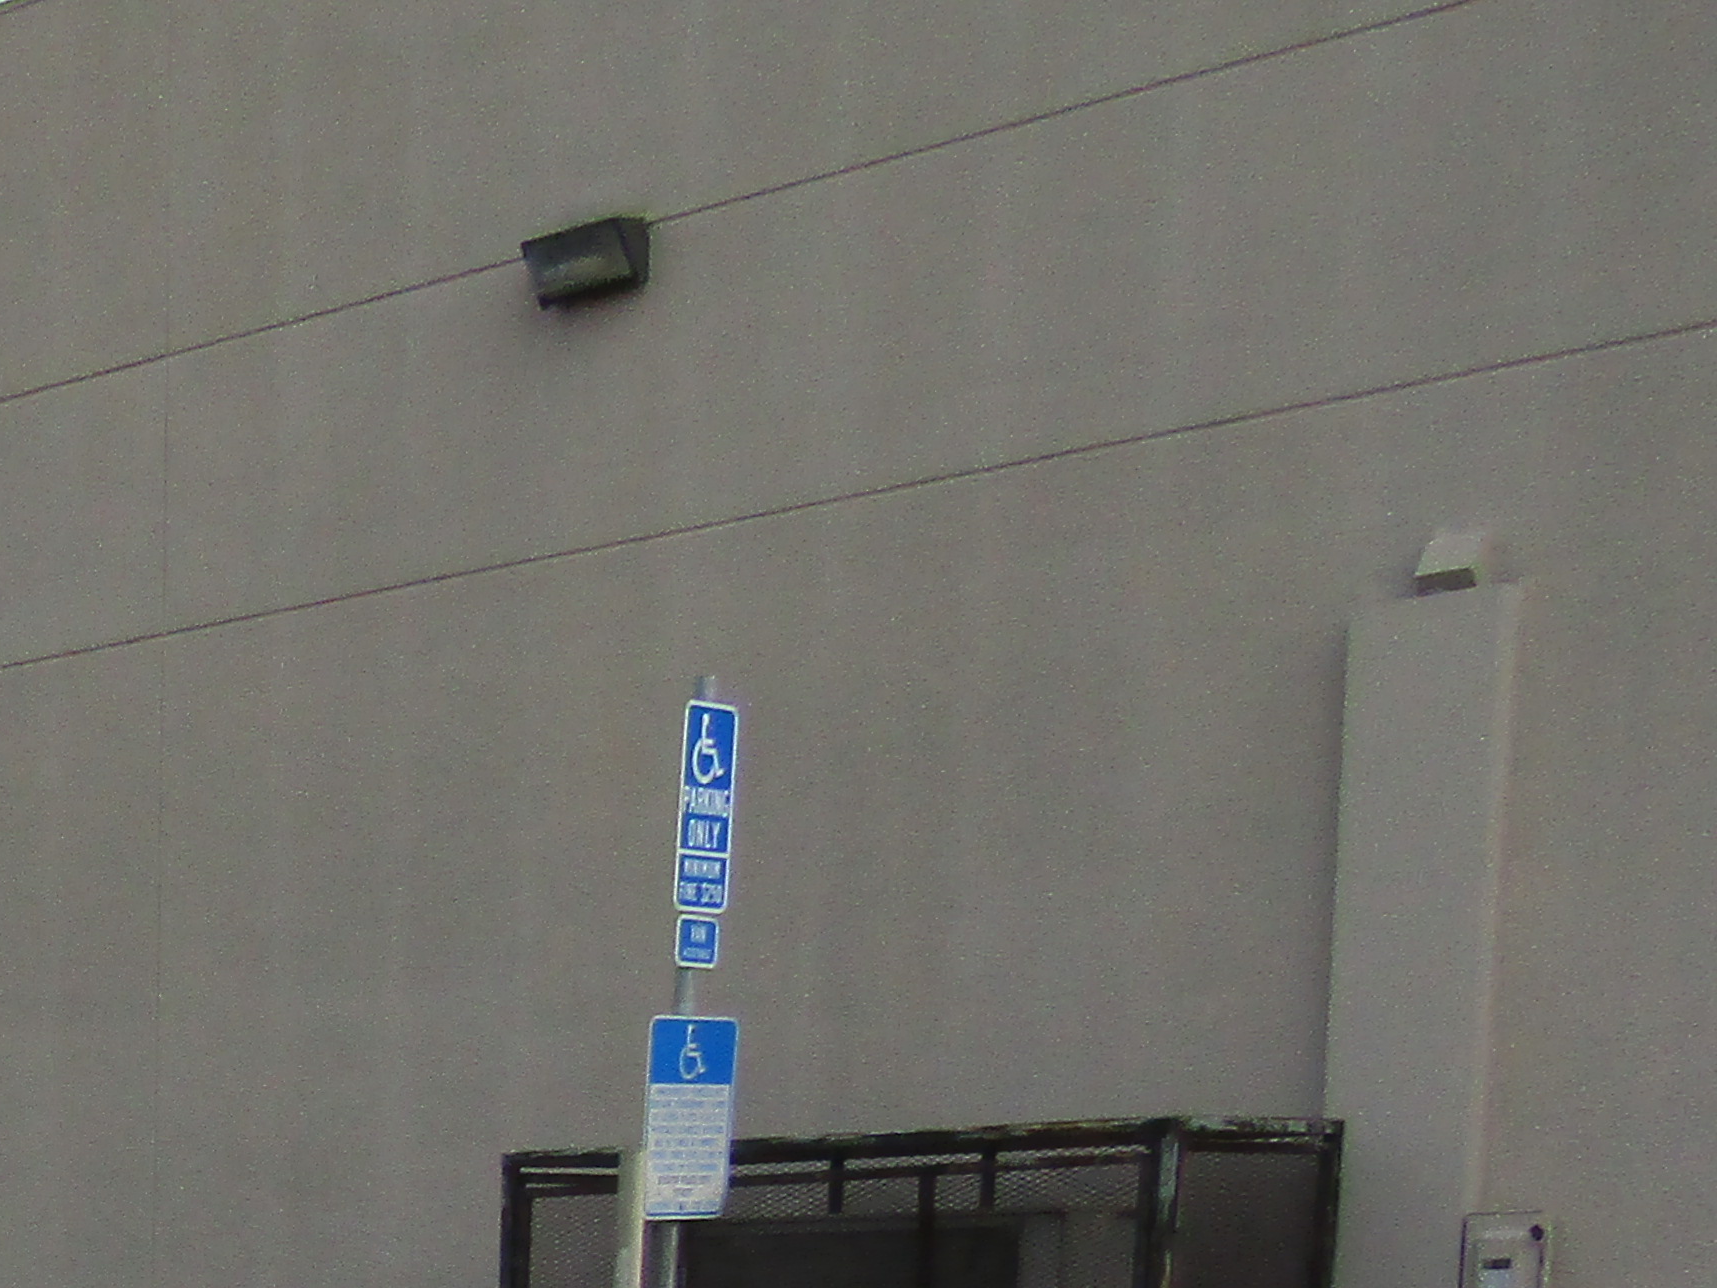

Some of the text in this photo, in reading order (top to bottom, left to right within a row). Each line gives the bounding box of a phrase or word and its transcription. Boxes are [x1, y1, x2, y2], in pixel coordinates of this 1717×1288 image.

[683, 786, 729, 817] PARKING
[687, 819, 720, 848] ONLY
[683, 858, 721, 879] MINIMUM
[678, 881, 698, 902] FINE
